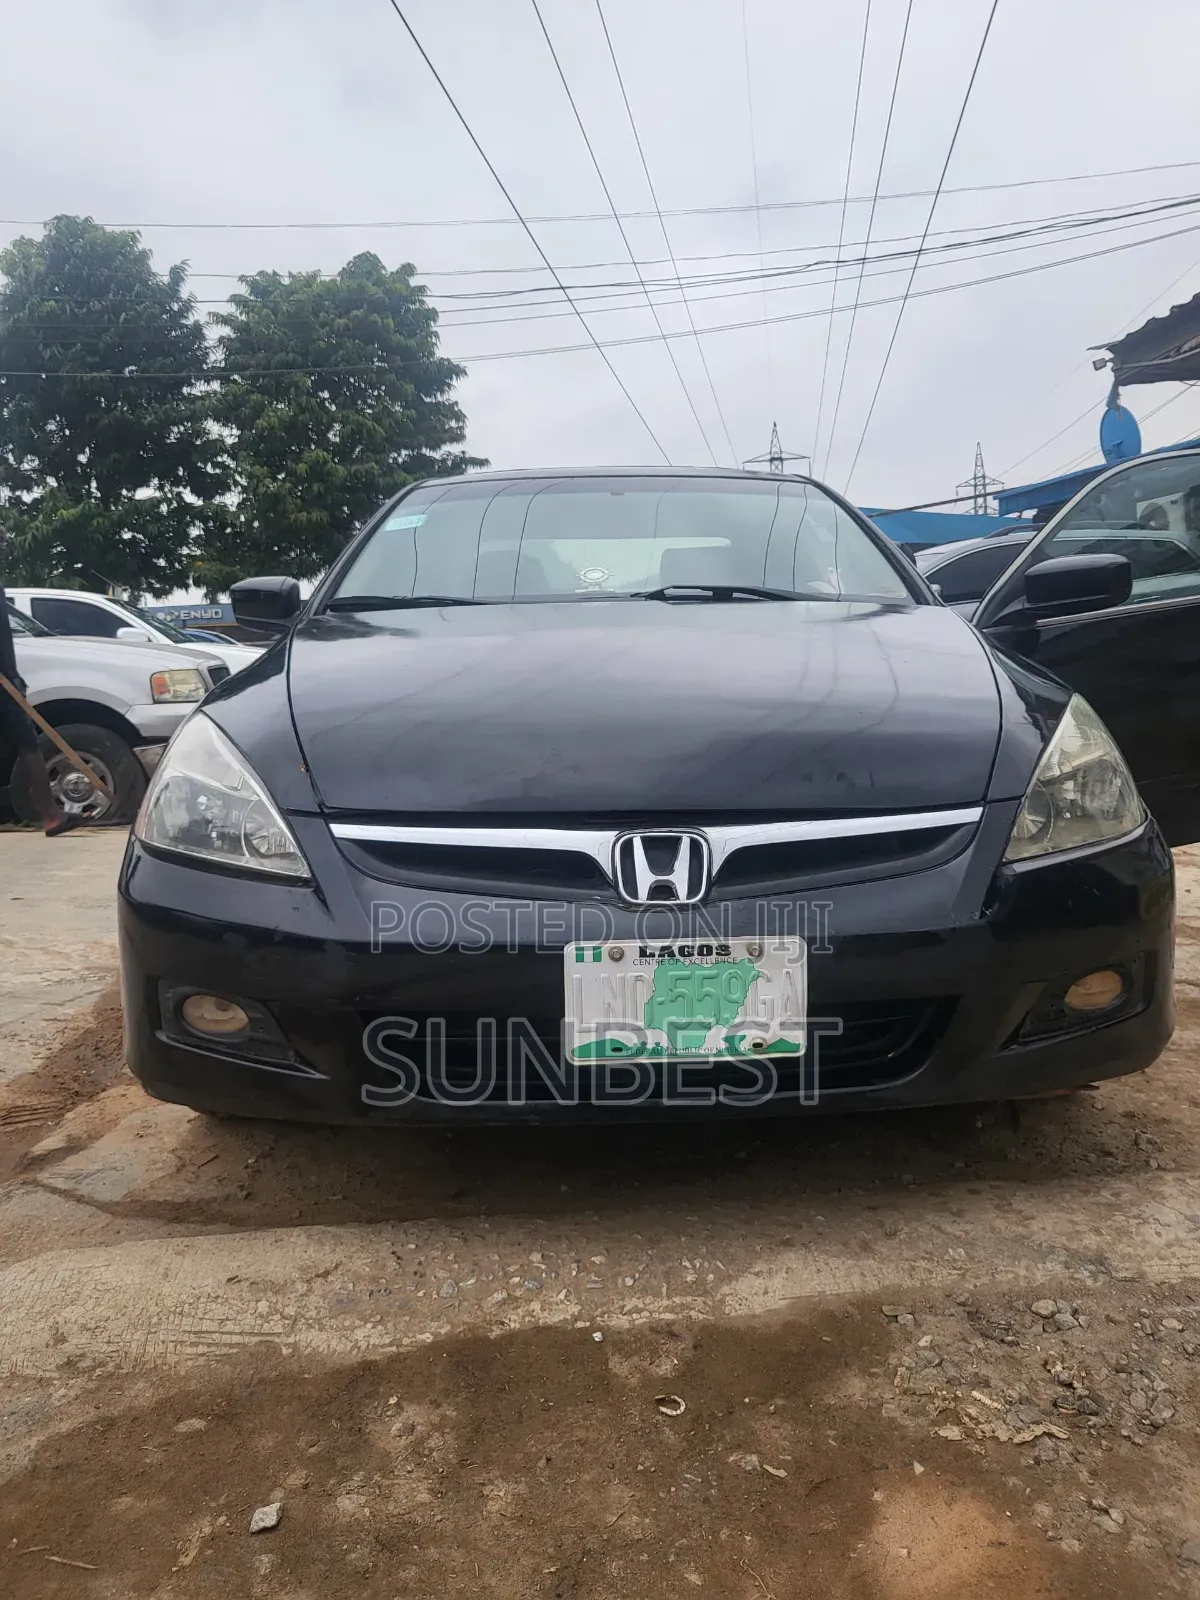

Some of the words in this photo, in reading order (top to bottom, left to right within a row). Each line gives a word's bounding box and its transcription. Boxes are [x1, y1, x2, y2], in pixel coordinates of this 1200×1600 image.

[638, 944, 732, 959] LAGOS
[632, 957, 666, 967] CENTRE
[667, 957, 681, 966] OF
[683, 955, 739, 966] EXCELLENCE
